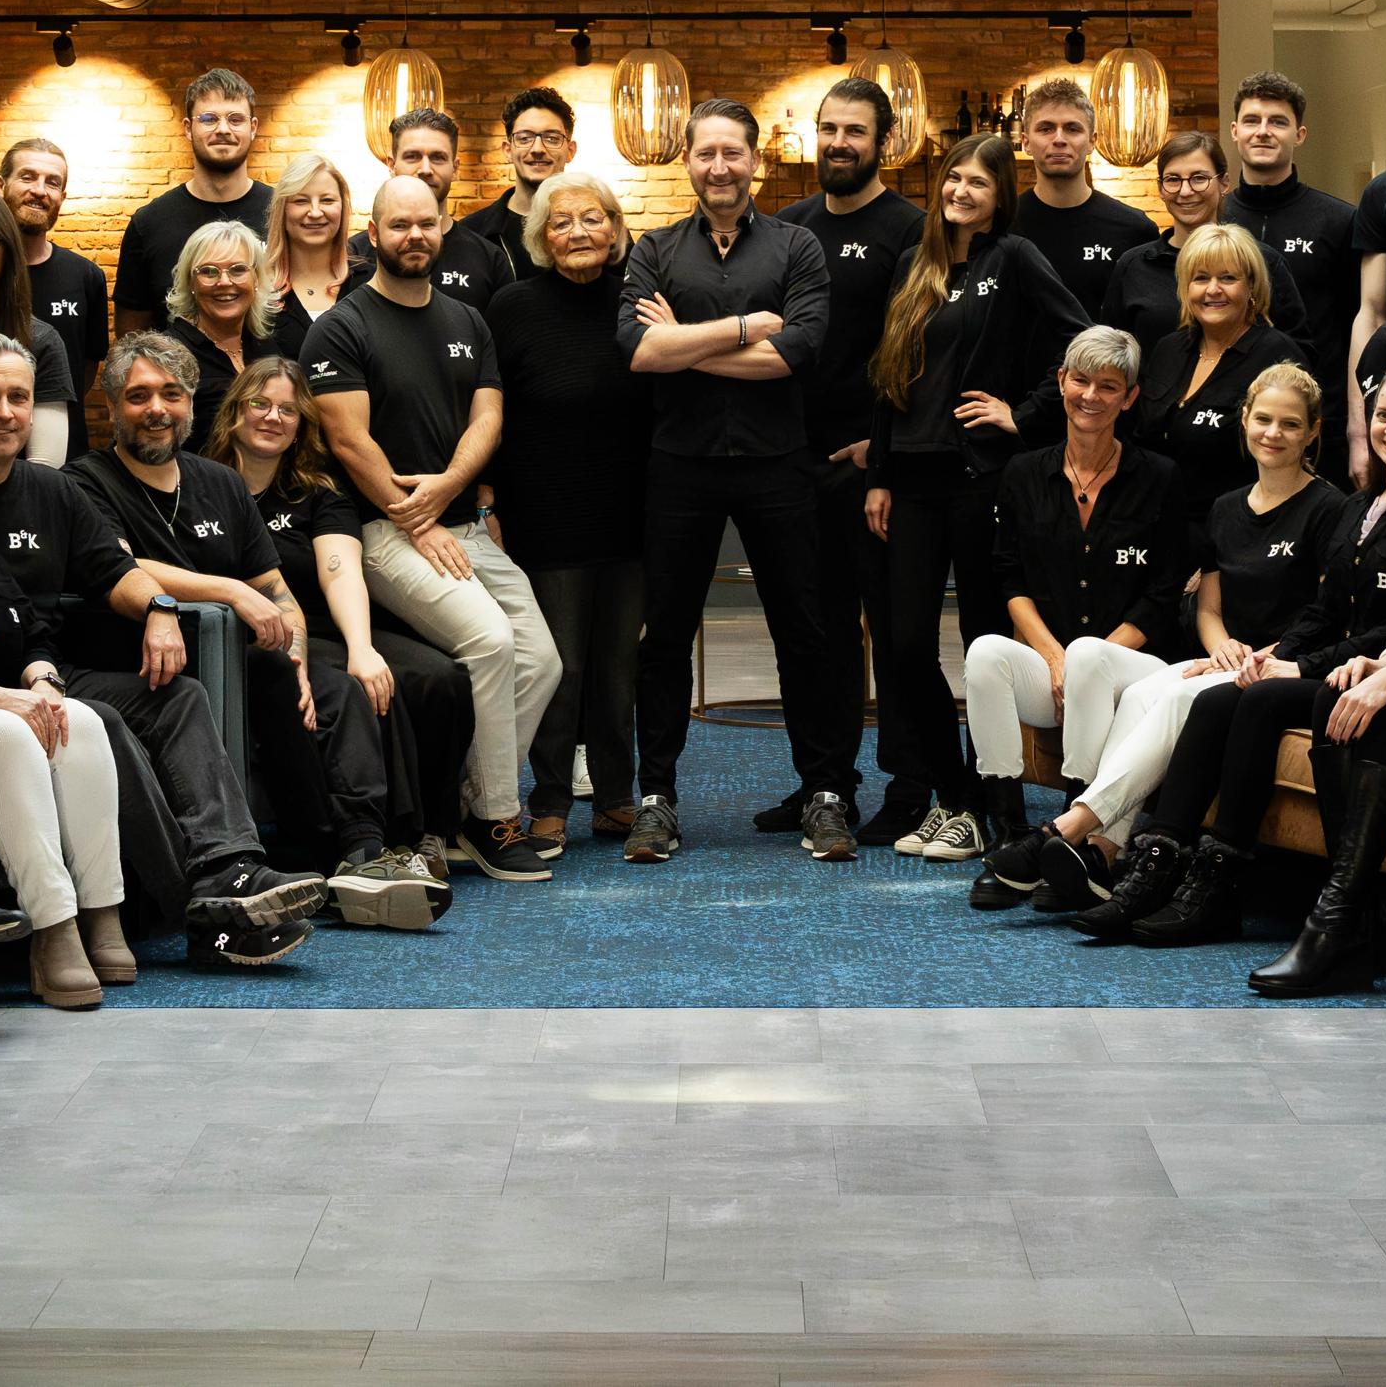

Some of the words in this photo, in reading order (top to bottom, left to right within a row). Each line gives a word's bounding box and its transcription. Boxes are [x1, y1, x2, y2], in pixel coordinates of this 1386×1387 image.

[839, 242, 868, 259] B&K
[1083, 243, 1113, 261] B&K
[1284, 237, 1314, 254] B&K
[441, 270, 470, 288] B&K
[51, 298, 79, 316] B&K
[447, 341, 474, 360] B&K
[1193, 408, 1224, 428] B&K
[193, 519, 225, 538] B&K
[268, 513, 293, 532] B&K
[8, 529, 40, 549] B&K
[1116, 546, 1148, 565] B&K
[1267, 540, 1295, 558] B&K
